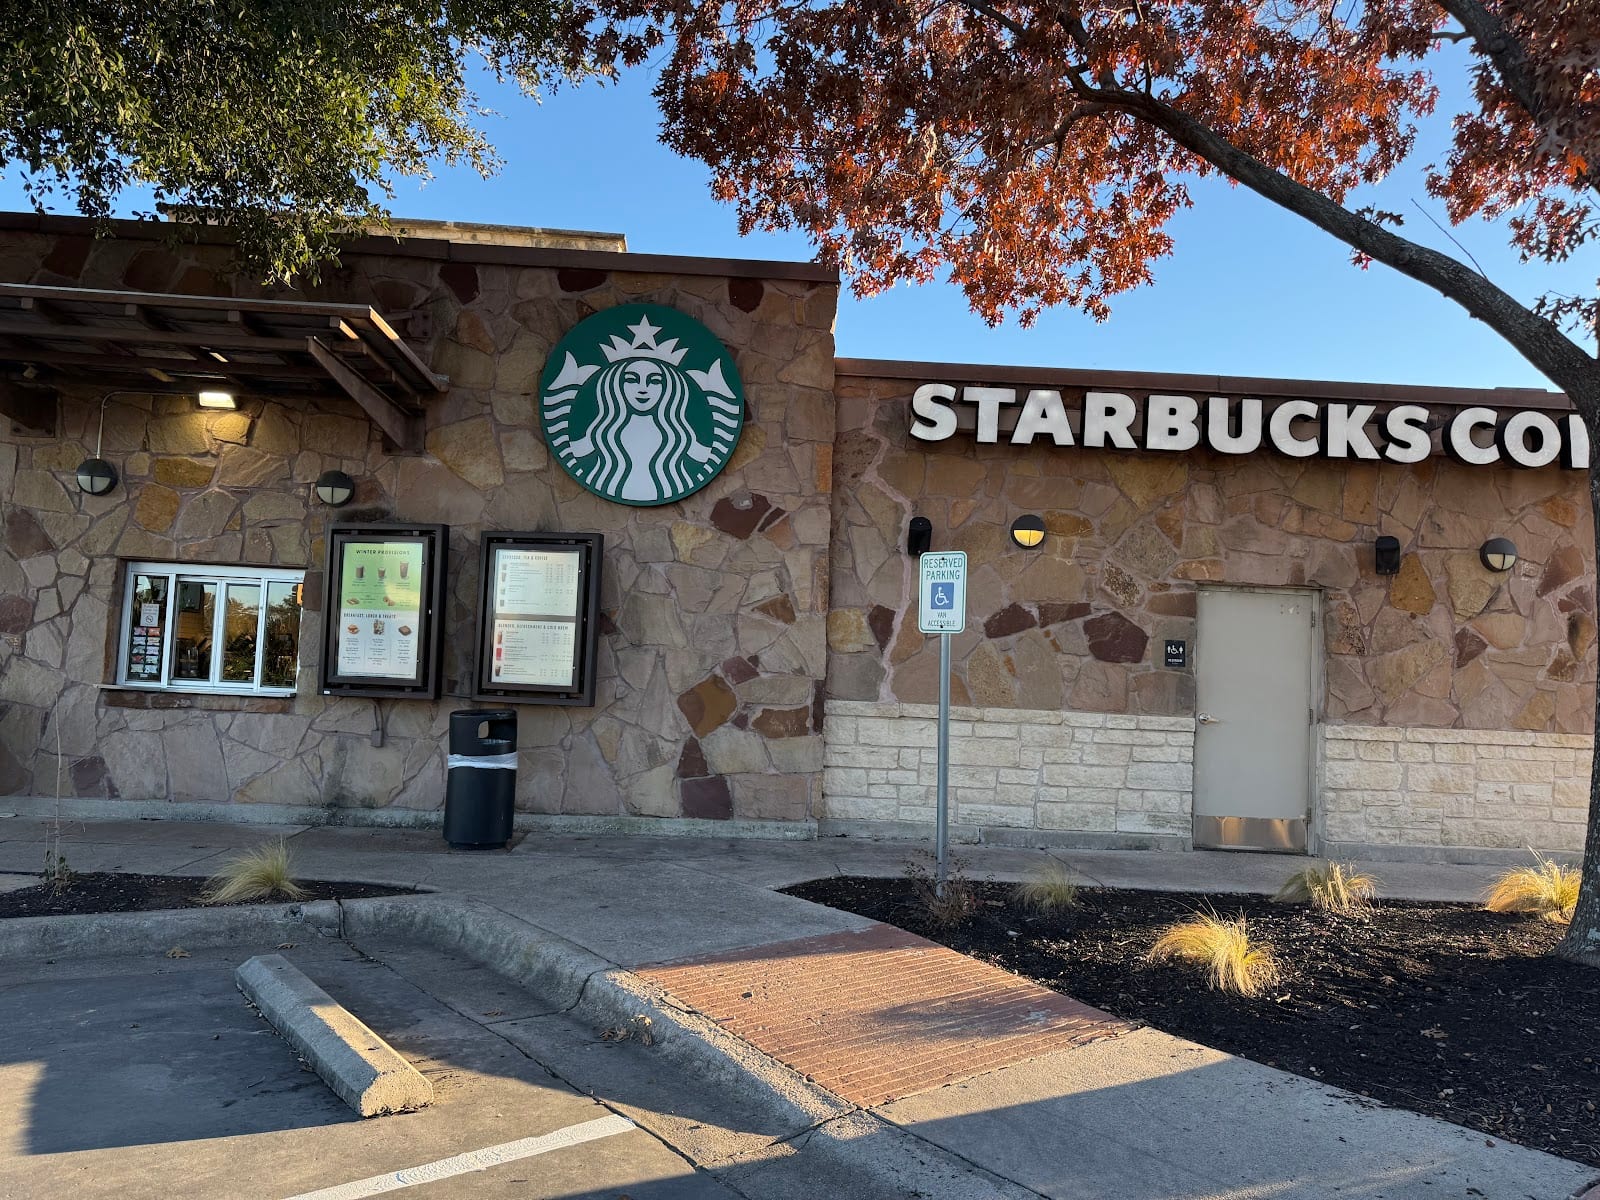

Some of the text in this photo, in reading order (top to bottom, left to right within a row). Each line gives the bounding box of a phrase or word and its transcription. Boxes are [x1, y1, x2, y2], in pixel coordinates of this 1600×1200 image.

[909, 383, 1432, 463] STARBUCKS
[924, 557, 963, 569] RESERVED
[926, 570, 960, 581] PARKING
[936, 611, 947, 619] VAN
[927, 619, 956, 627] ACCESSIBLE
